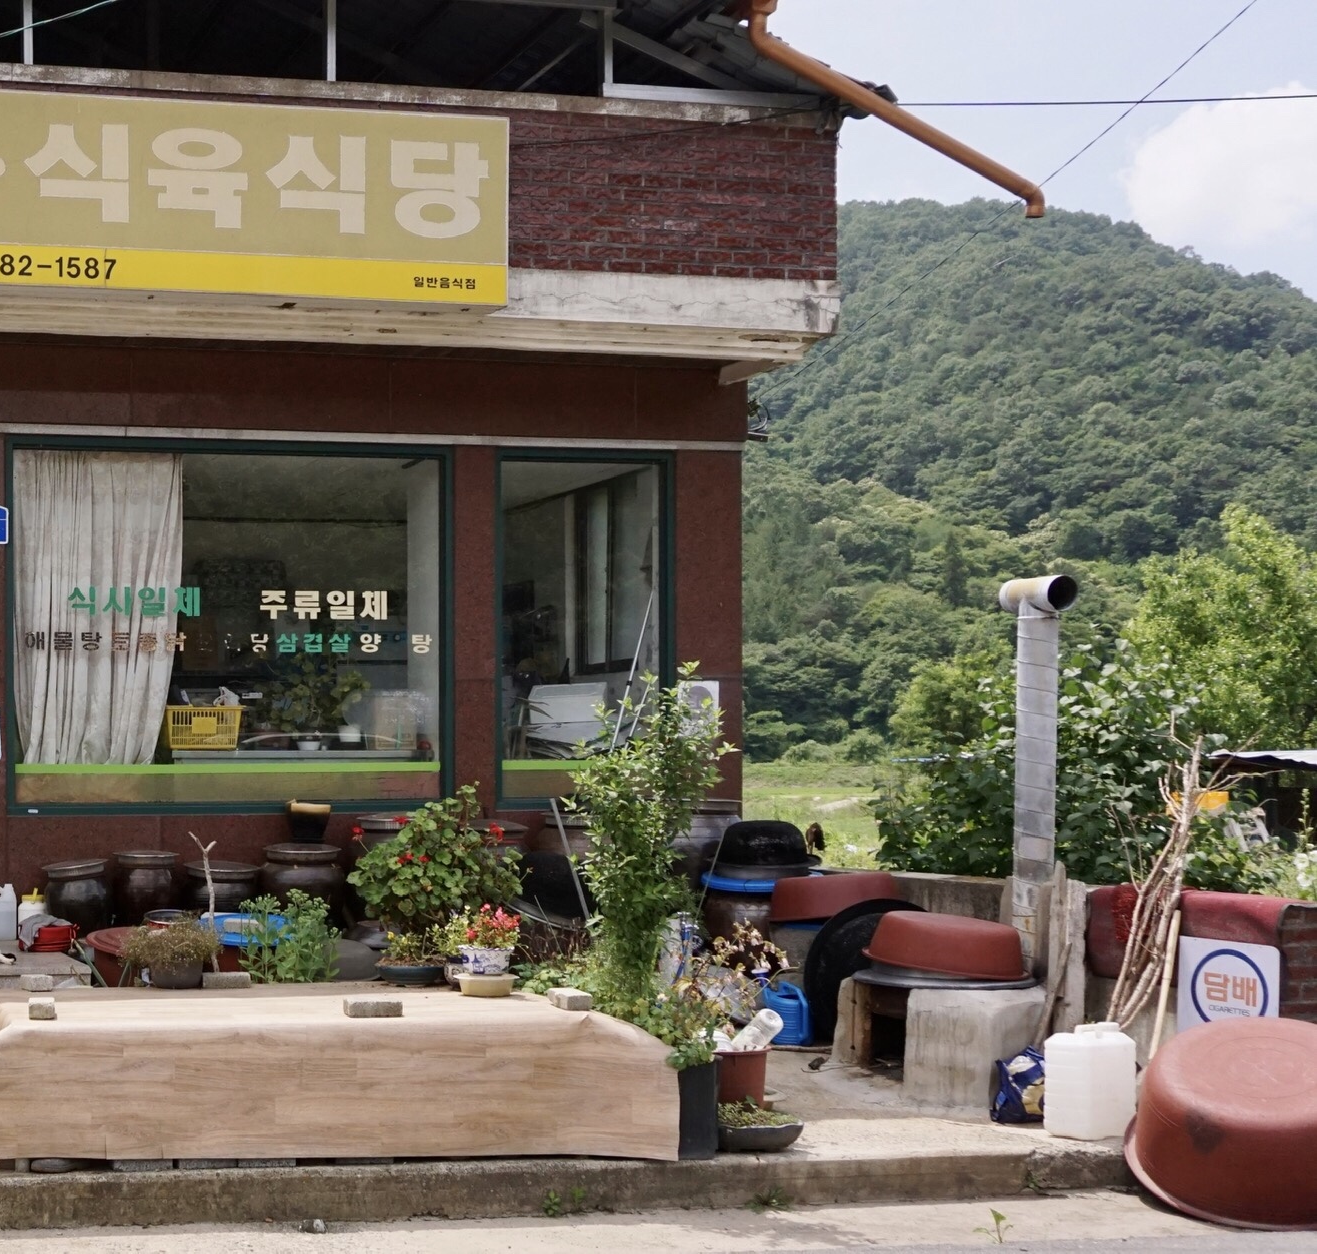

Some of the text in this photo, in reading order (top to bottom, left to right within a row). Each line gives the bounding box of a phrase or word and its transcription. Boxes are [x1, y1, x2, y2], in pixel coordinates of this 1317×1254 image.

[24, 123, 489, 239] 식육식당
[413, 276, 476, 290] 일반음식점
[259, 589, 388, 620] 주류일체
[276, 633, 351, 653] 삼겹살
[1203, 971, 1257, 1008] 담배
